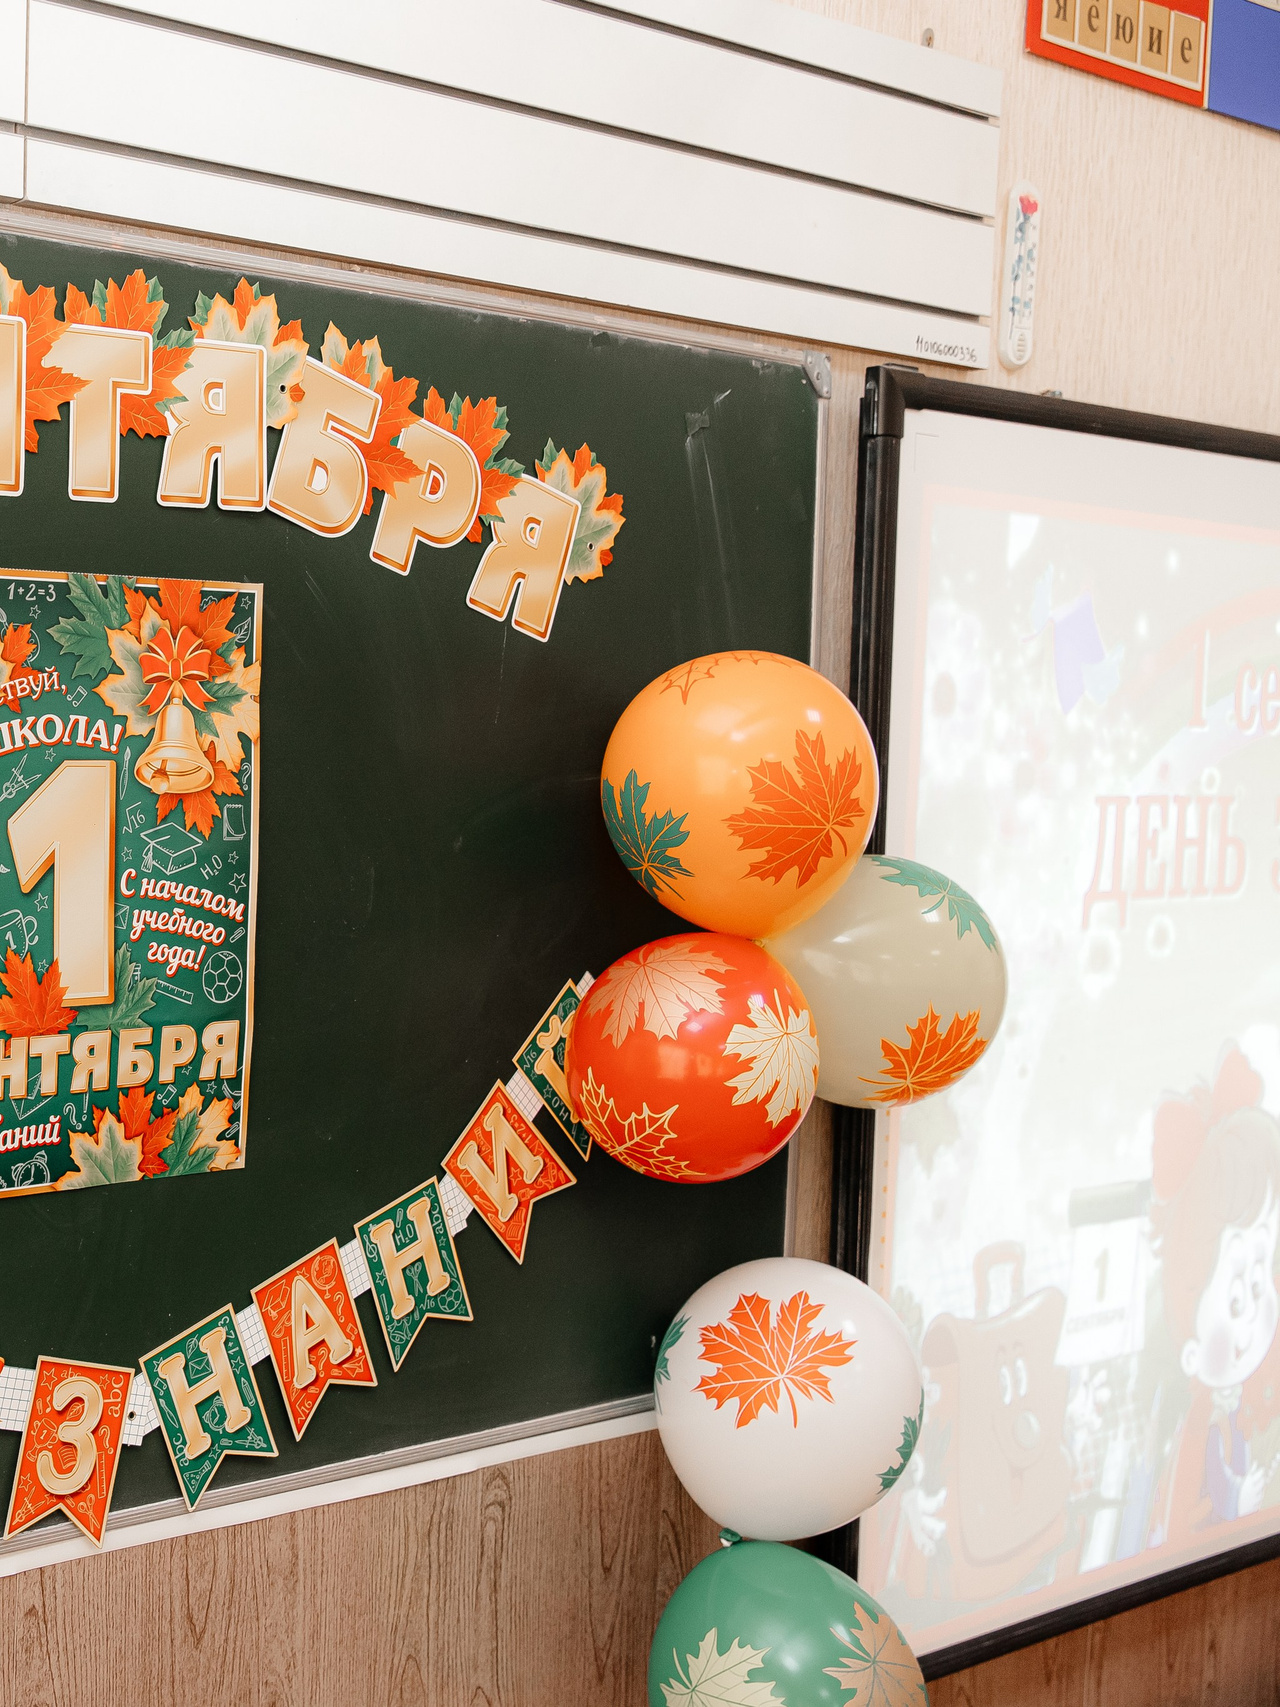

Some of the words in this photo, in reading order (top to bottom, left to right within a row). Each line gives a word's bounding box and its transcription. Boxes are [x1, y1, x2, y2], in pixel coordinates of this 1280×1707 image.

[1149, 25, 1163, 56] и
[6, 581, 58, 602] 1+2=3
[1081, 794, 1248, 930] ДЕНЬ
[8, 760, 117, 1007] 1
[120, 868, 137, 898] С
[140, 876, 246, 923] началом
[129, 907, 227, 946] учебного
[147, 942, 208, 978] года!
[431, 1203, 445, 1236] abc
[104, 1374, 125, 1418] abc
